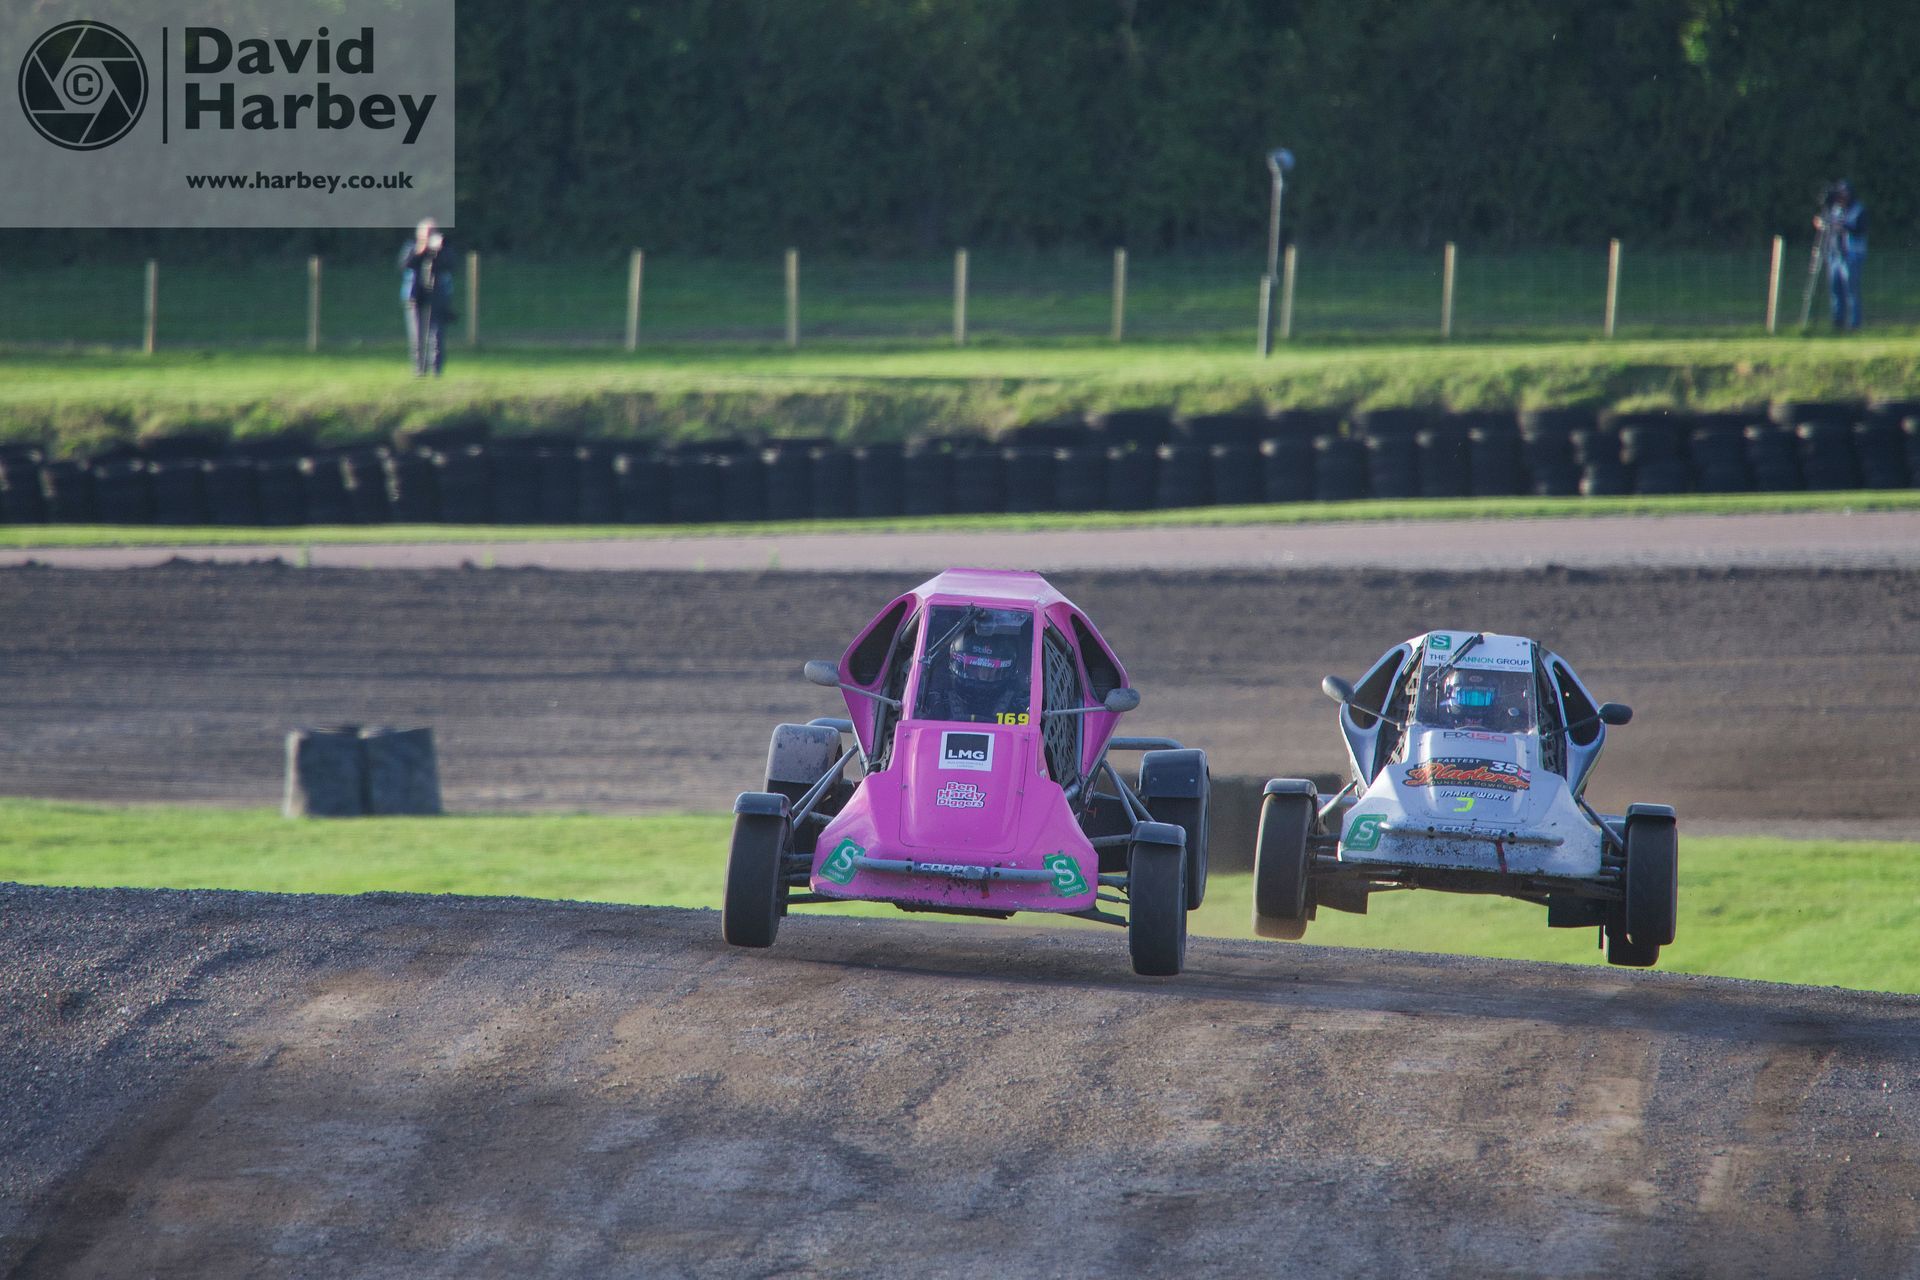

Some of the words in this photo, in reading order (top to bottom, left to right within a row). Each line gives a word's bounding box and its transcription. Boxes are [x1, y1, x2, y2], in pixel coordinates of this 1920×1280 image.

[1429, 653, 1446, 661] THE
[1450, 655, 1494, 664] ANNON
[1496, 657, 1530, 666] GROUP
[996, 712, 1030, 726] 169
[947, 749, 985, 760] LMG
[1490, 761, 1519, 774] 35
[946, 782, 977, 791] Ben
[938, 789, 985, 800] Hardy
[937, 798, 984, 808] Diggers
[1355, 821, 1377, 841] S
[832, 846, 858, 870] S
[1053, 859, 1076, 886] S
